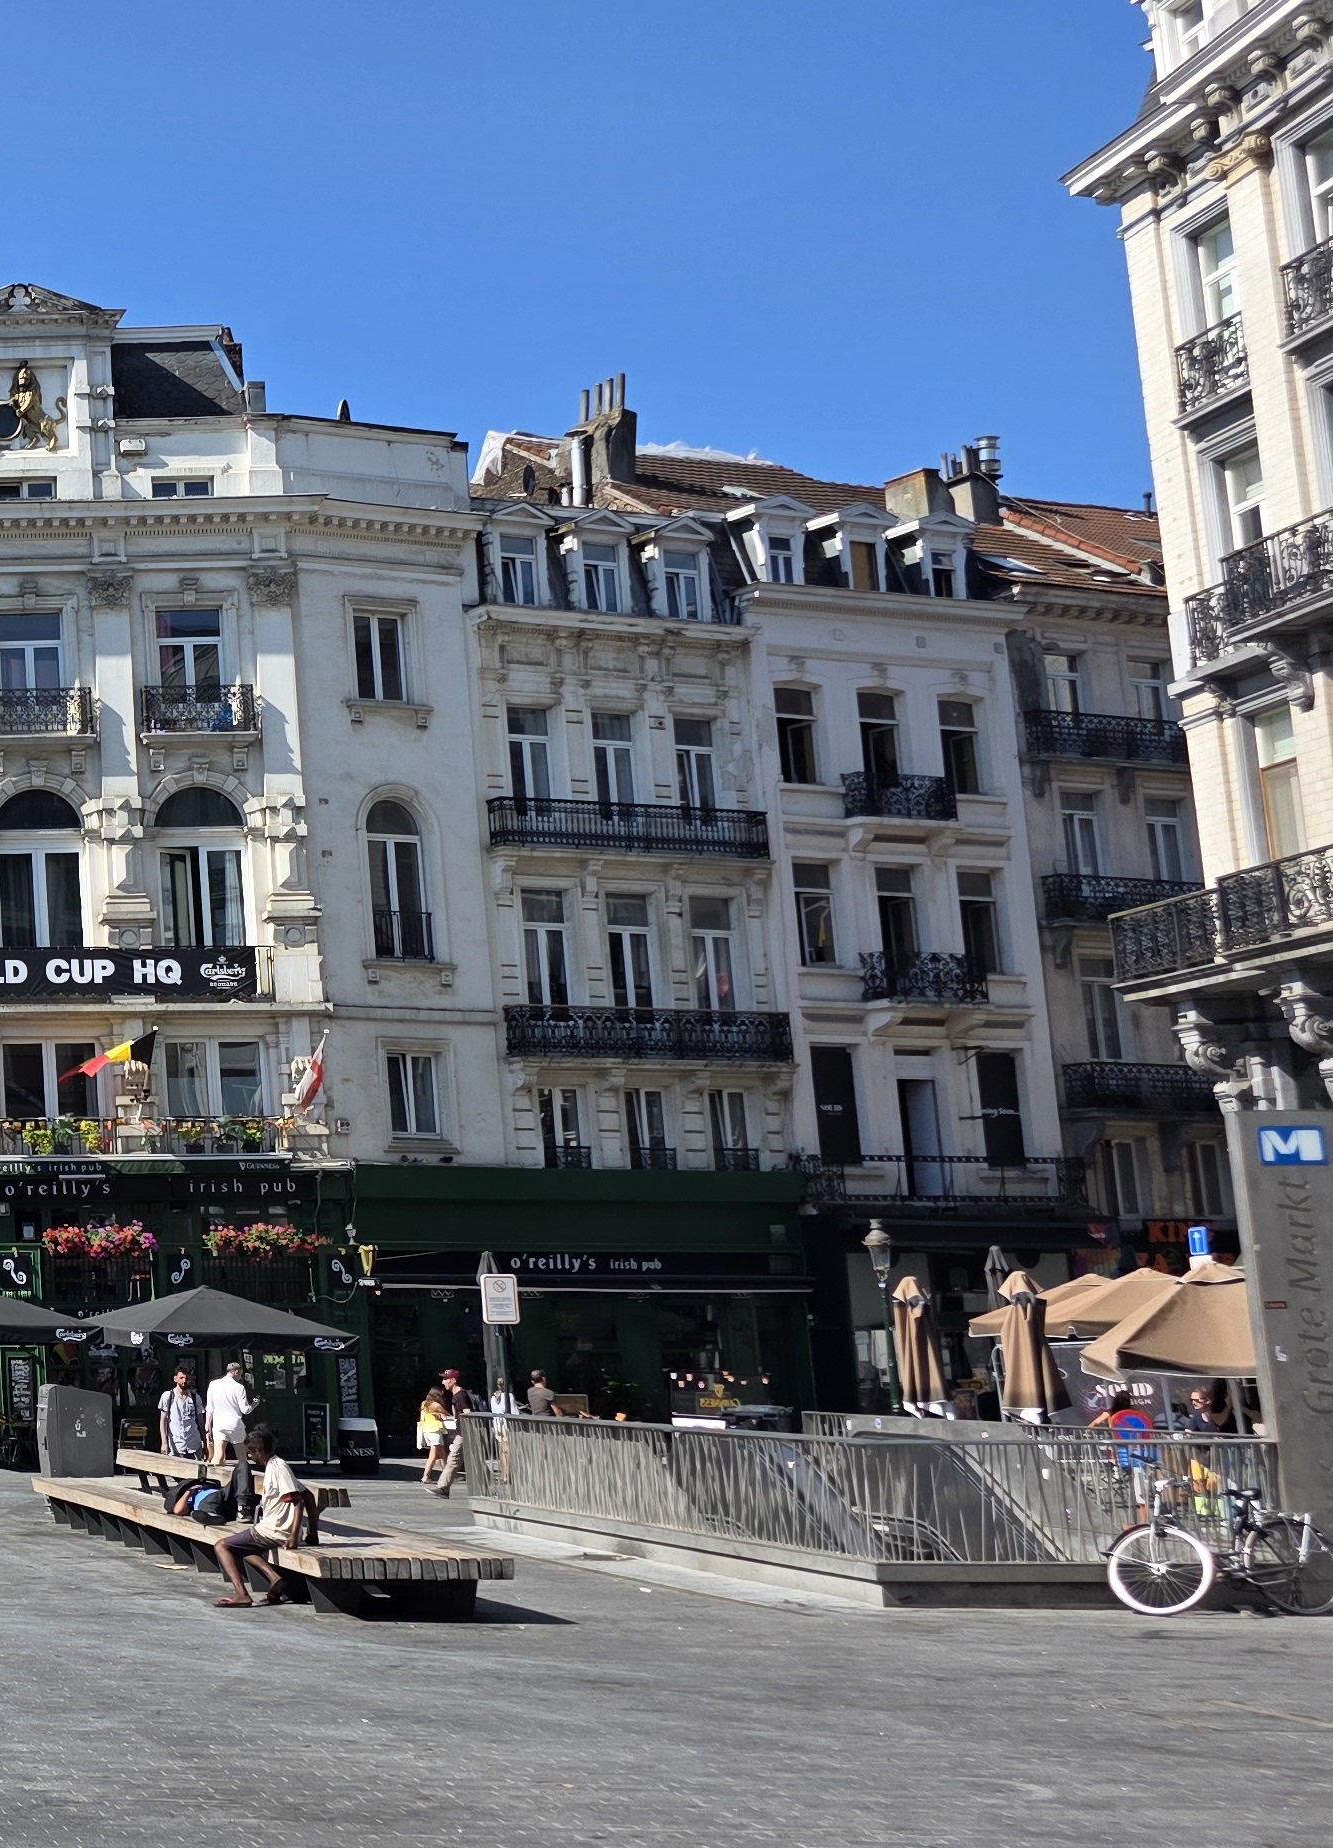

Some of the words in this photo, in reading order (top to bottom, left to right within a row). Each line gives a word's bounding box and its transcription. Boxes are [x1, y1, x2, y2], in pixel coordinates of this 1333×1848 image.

[46, 959, 116, 984] CUP
[133, 959, 182, 985] HQ
[200, 963, 246, 979] Carlsberg
[49, 1163, 77, 1172] irish
[81, 1163, 102, 1173] pub
[4, 1180, 111, 1197] o'reilly's
[189, 1179, 243, 1193] irish
[261, 1178, 296, 1195] pub
[1276, 1176, 1323, 1293] Markt
[511, 1254, 596, 1272] o'reilly's
[610, 1258, 637, 1269] irish
[642, 1258, 662, 1271] pub
